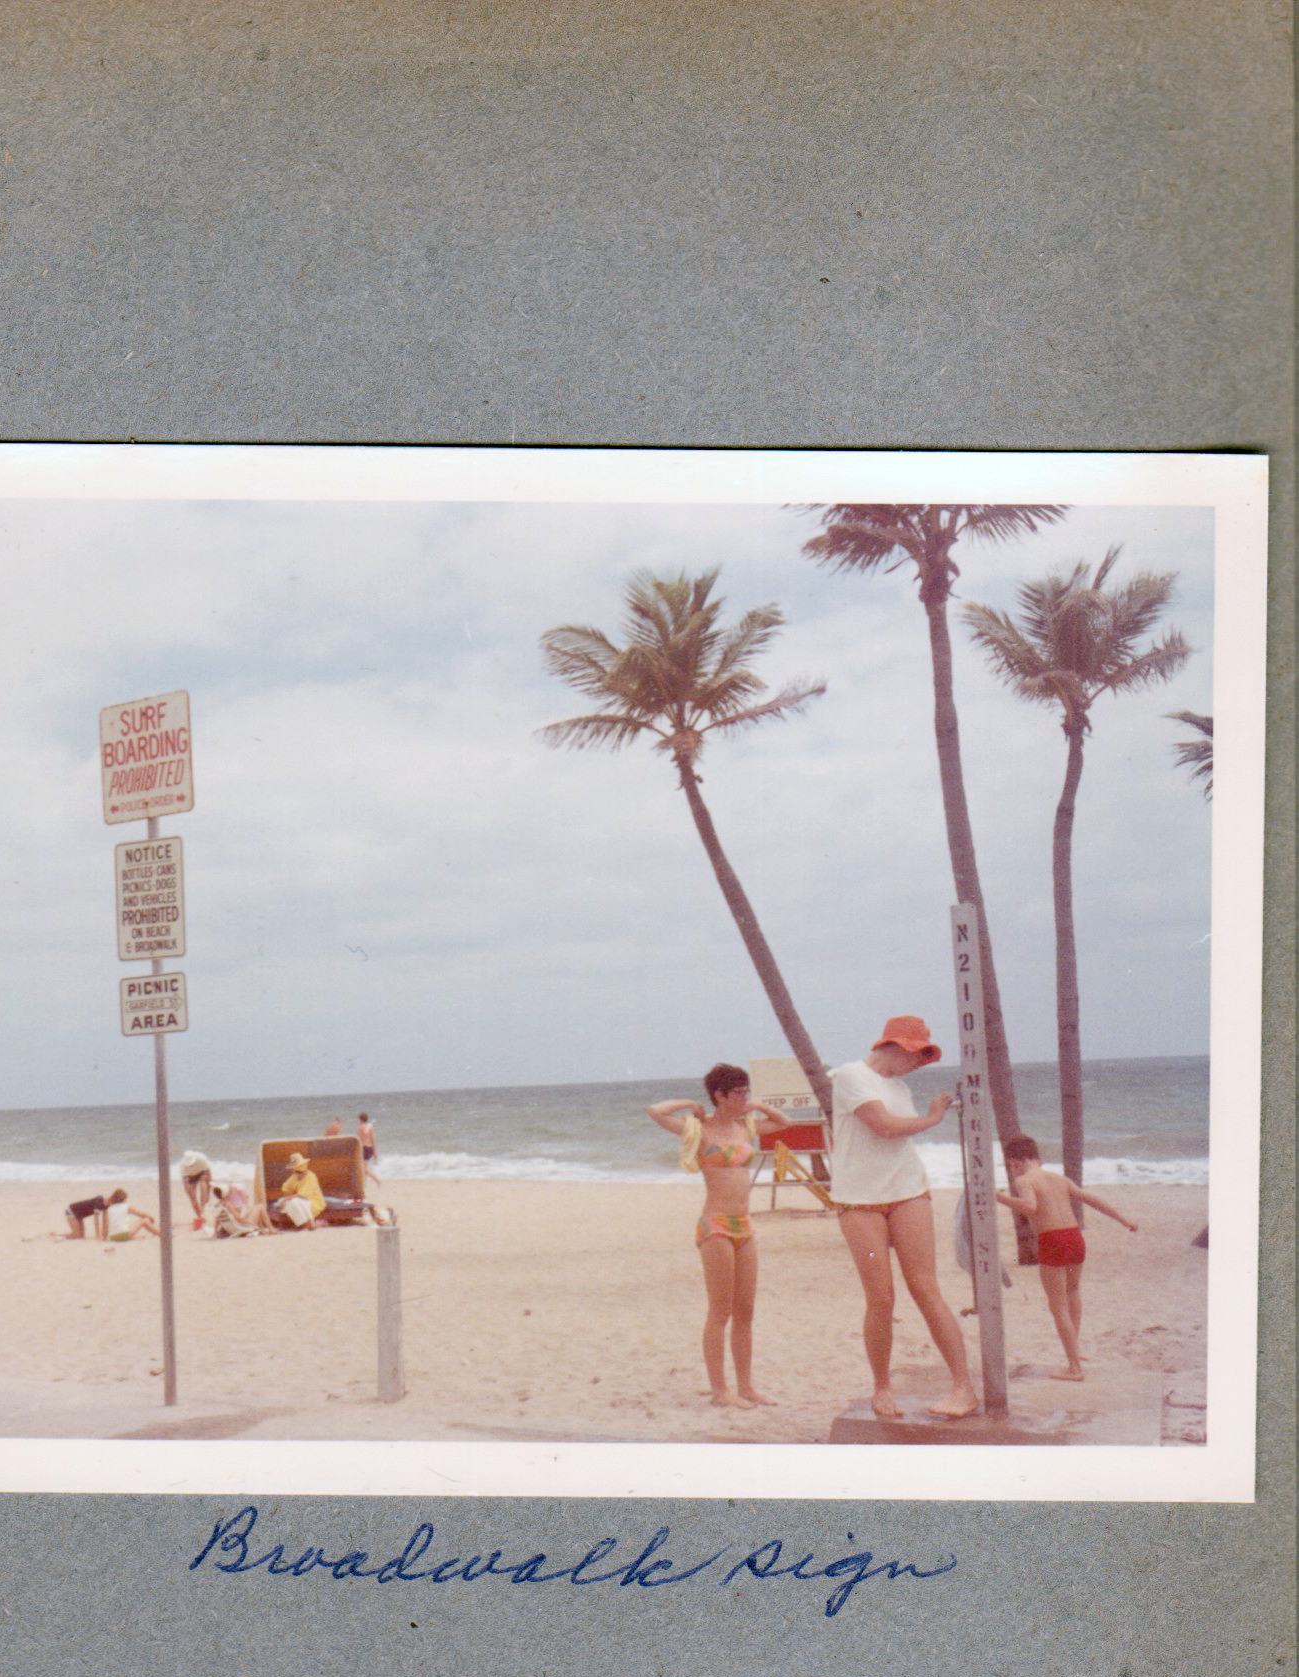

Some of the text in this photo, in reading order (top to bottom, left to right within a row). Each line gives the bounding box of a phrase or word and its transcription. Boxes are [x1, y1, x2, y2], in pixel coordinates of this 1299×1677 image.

[119, 701, 167, 737] SURF
[103, 726, 189, 768] BOARDING
[108, 758, 185, 798] PROHIBITED
[125, 844, 172, 864] NOTICE
[123, 892, 177, 907] AND VEHICLES
[122, 906, 179, 926] PROHIBITED
[131, 925, 171, 939] ON BEACH
[128, 978, 179, 997] PICNIC
[131, 1013, 178, 1030] AREA
[793, 1097, 810, 1107] OFF
[720, 1531, 960, 1618] sign
